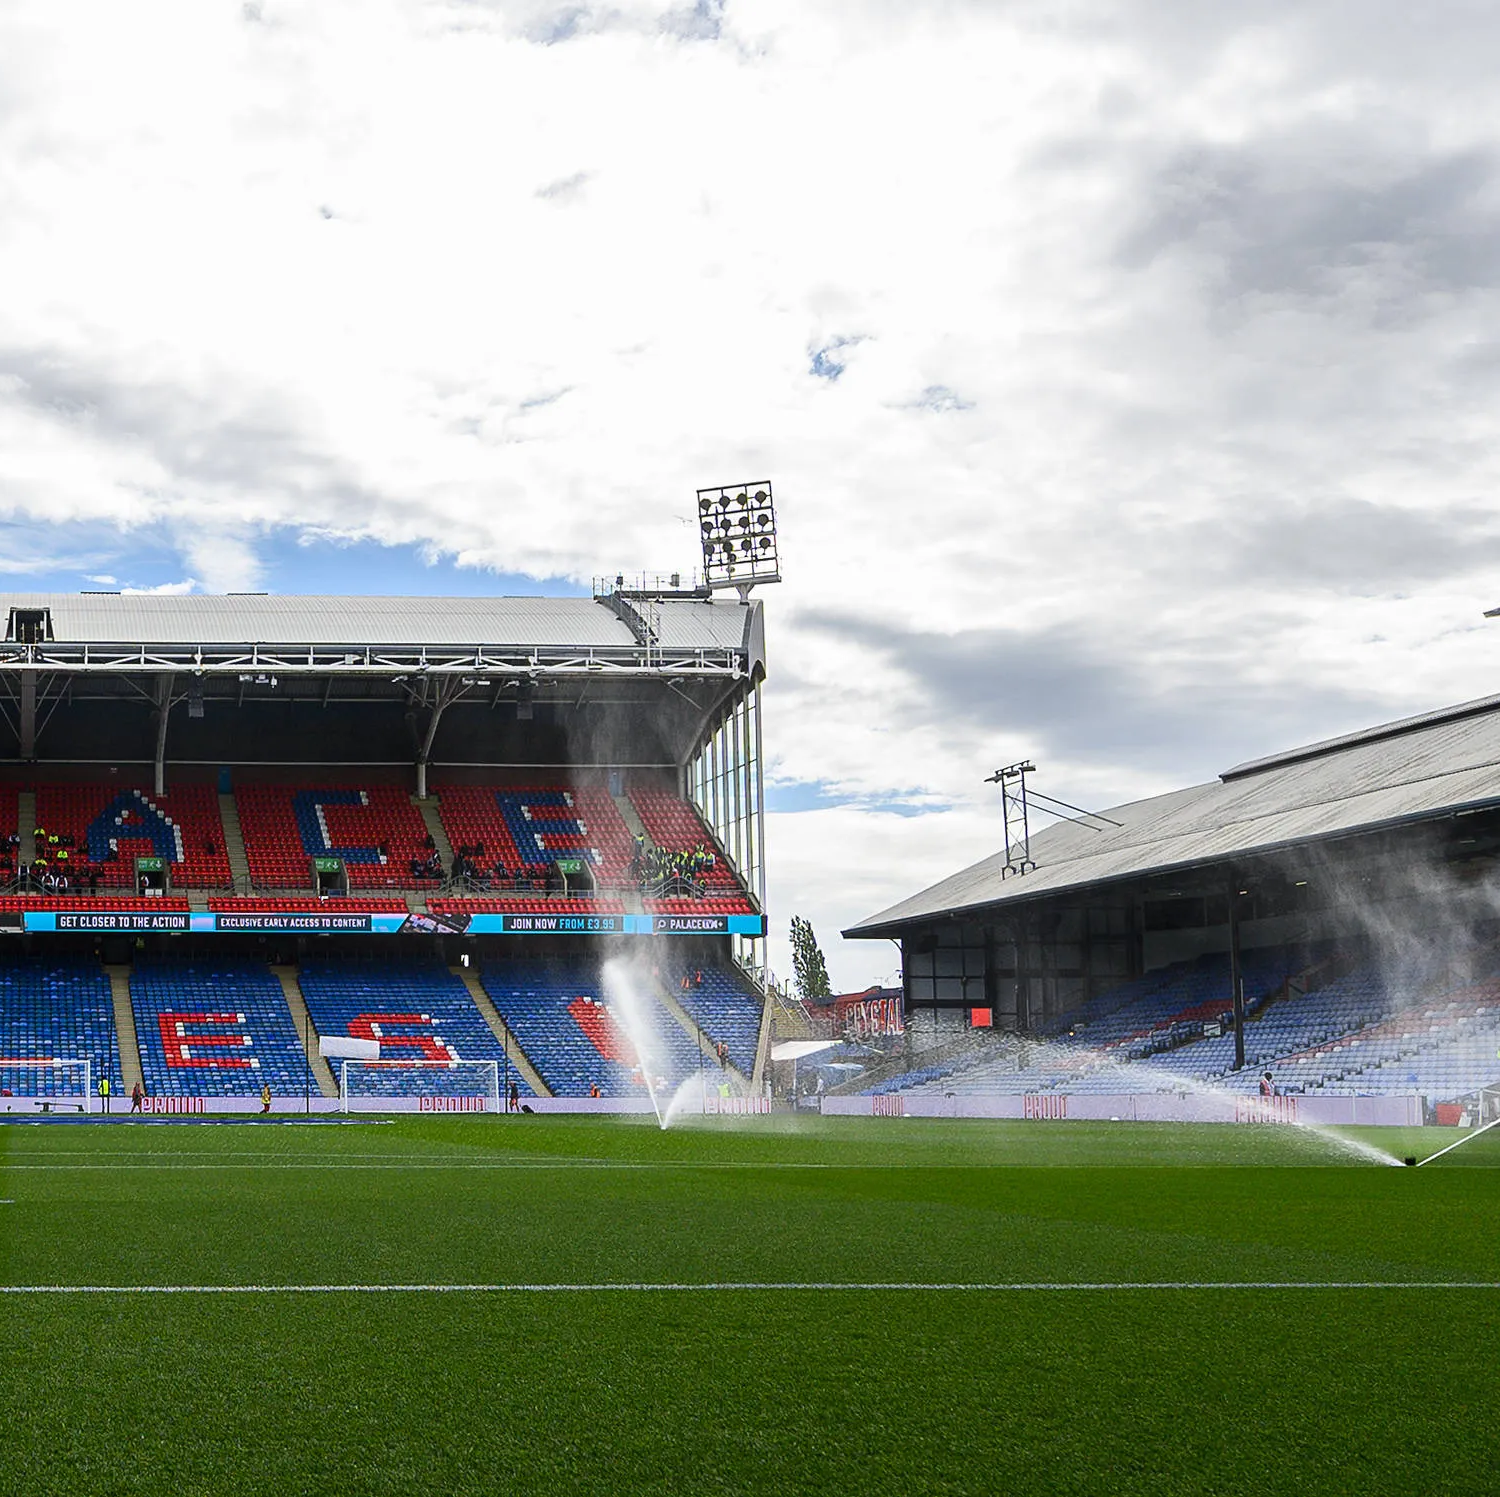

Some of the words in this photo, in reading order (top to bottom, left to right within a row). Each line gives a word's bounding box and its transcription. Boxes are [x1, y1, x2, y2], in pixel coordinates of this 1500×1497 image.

[60, 916, 78, 927] GET
[80, 916, 116, 927] CLOSER
[119, 916, 130, 927] TO
[132, 916, 150, 927] THE
[152, 916, 185, 927] ACTION
[220, 918, 262, 928] EXCLUSIVE
[264, 918, 288, 928] EARLY
[290, 918, 320, 928] ACCESS
[322, 918, 330, 928] TO
[332, 918, 366, 928] CONTENT
[510, 918, 534, 929] JOIN
[534, 918, 557, 929] NOW
[559, 918, 584, 929] FROM
[588, 918, 614, 929] £3.99
